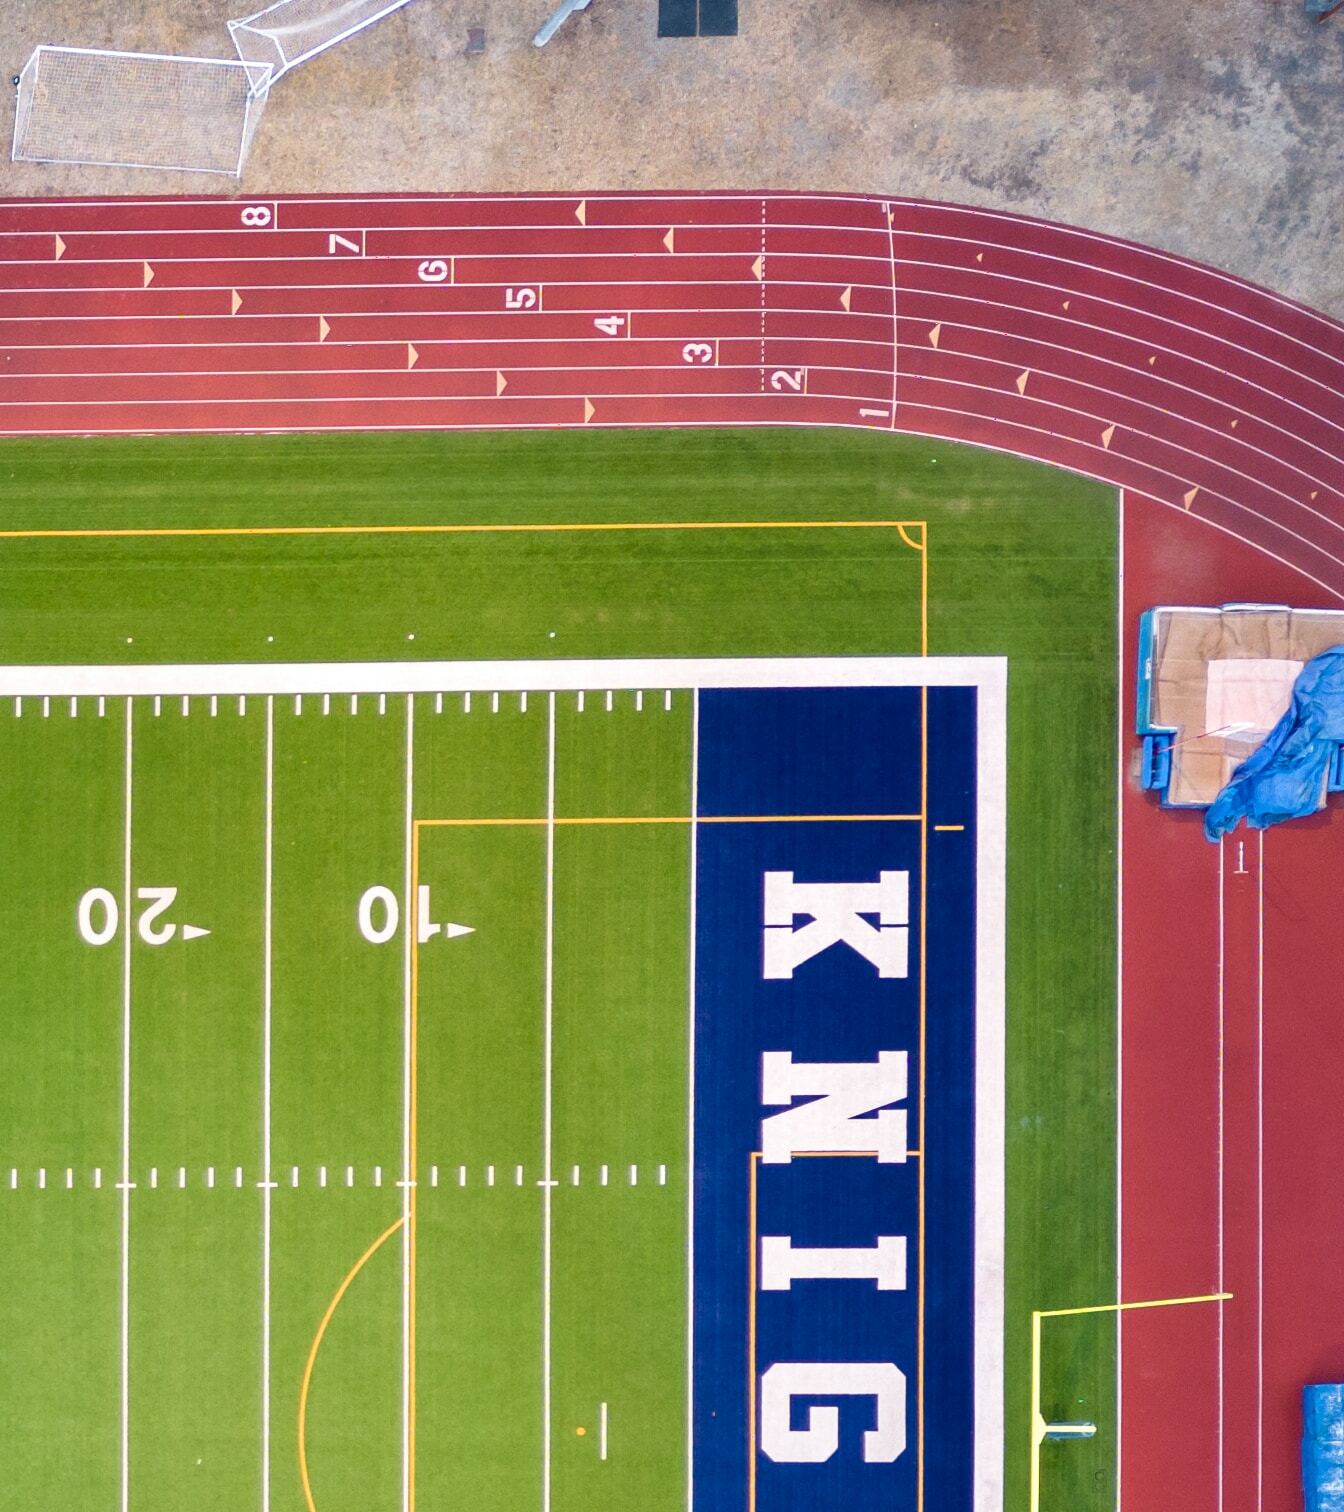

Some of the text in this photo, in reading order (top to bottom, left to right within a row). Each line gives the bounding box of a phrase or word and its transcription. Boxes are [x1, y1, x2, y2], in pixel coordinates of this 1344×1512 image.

[241, 206, 271, 226] 8
[328, 233, 360, 254] 7
[417, 260, 448, 281] 6
[505, 288, 536, 308] 5
[594, 315, 624, 335] 4
[682, 343, 713, 363] 3
[771, 370, 801, 391] 2
[859, 408, 890, 417] 1
[77, 887, 178, 946] 20
[358, 885, 441, 944] 10
